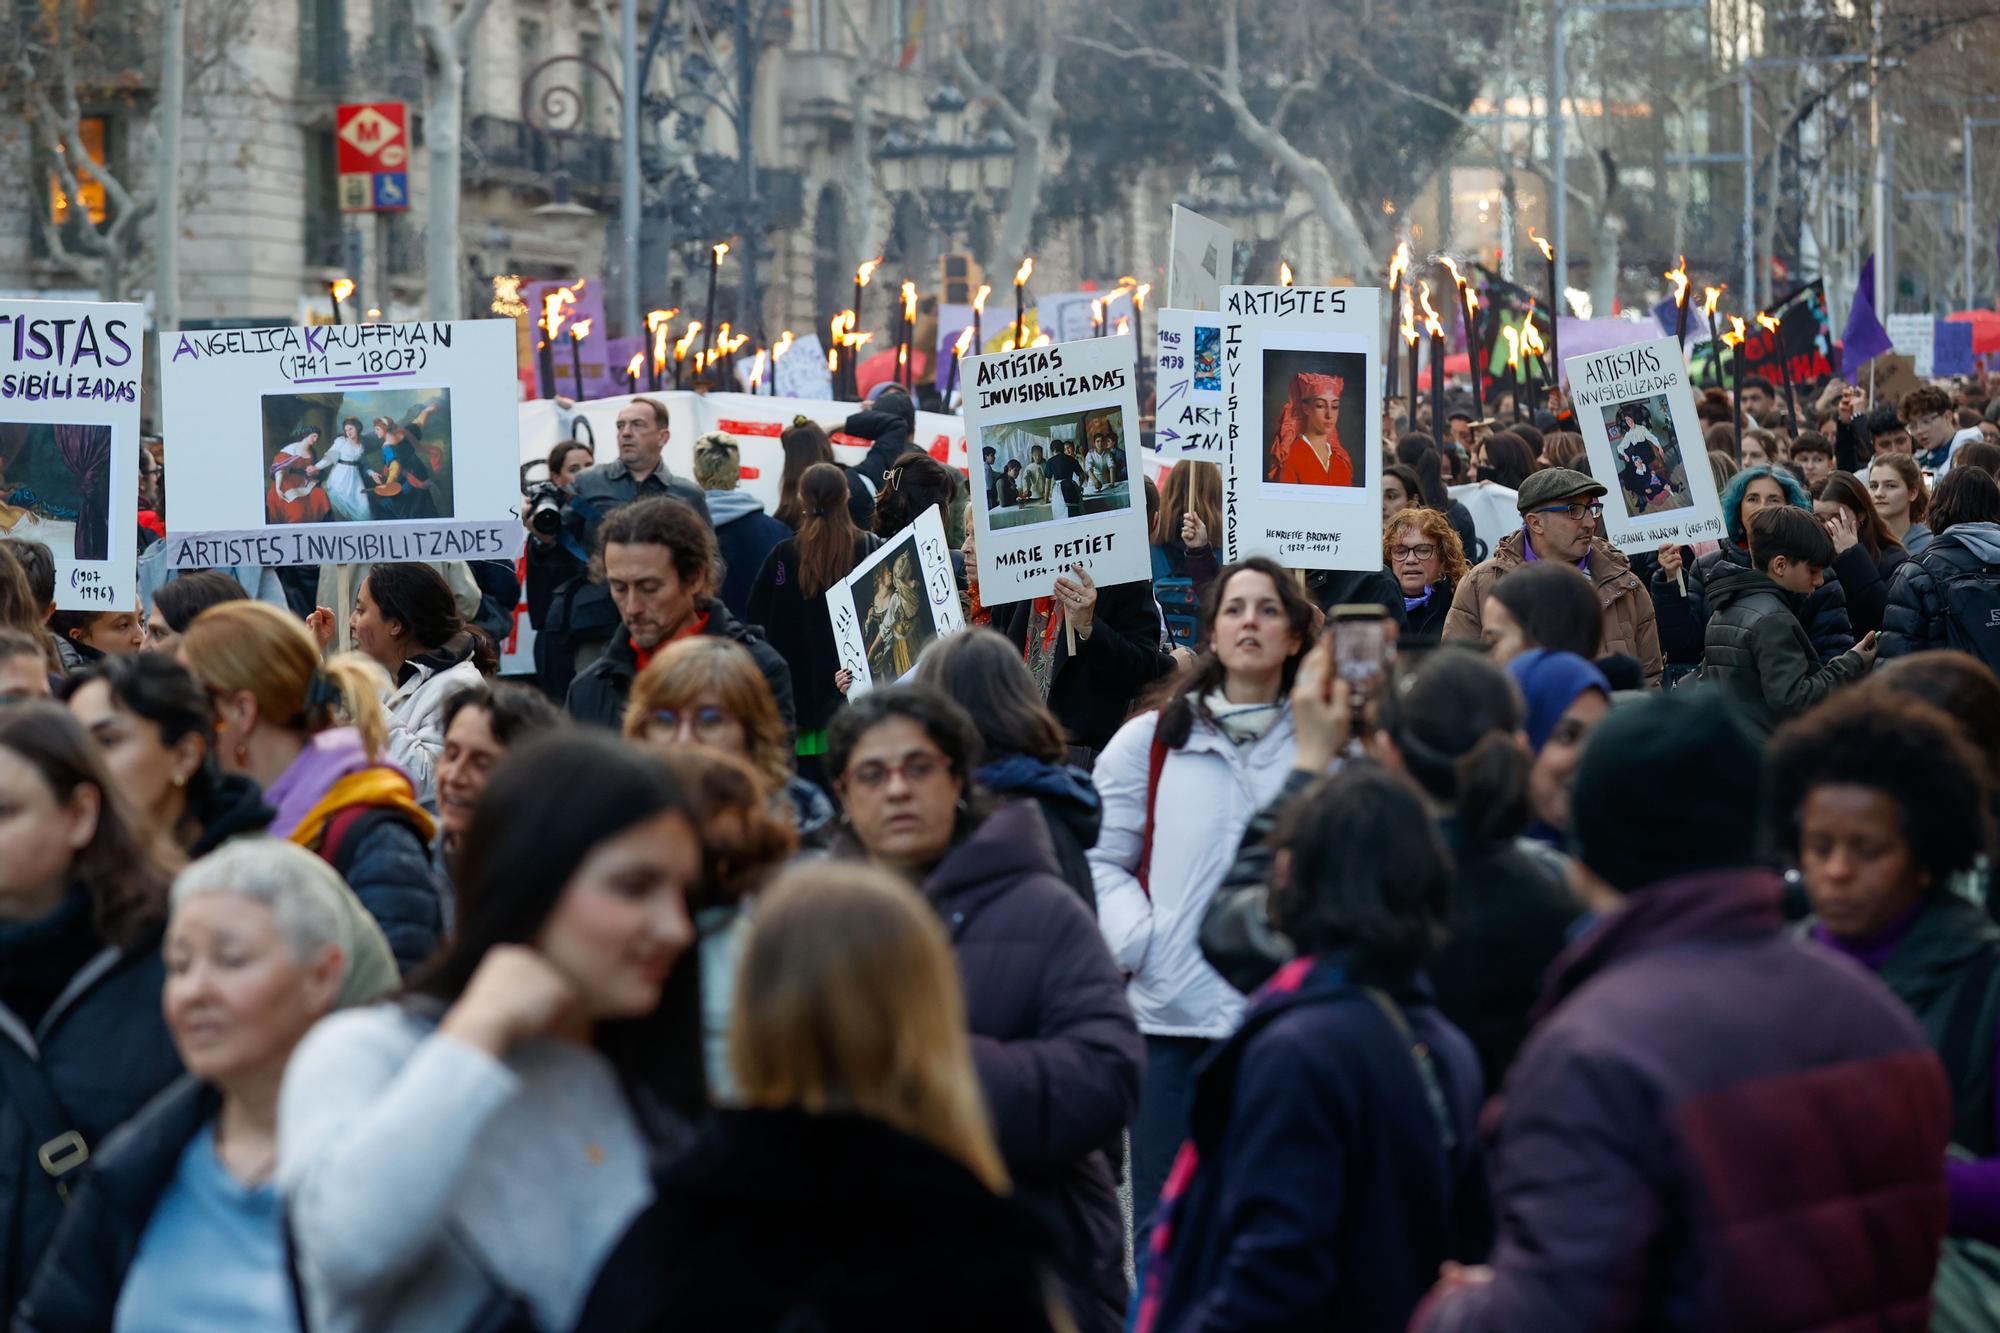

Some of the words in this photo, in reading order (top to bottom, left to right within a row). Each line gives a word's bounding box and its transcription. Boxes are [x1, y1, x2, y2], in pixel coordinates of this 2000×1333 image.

[357, 121, 380, 141] M
[1228, 290, 1346, 317] ARTISTES
[172, 326, 300, 362] ANGELICA
[304, 322, 451, 354] KAUFFMAN
[176, 535, 284, 565] ARTISTES
[291, 529, 504, 564] INVISIBILITZADES
[1306, 531, 1342, 542] BROWNE
[996, 545, 1042, 570] MARIE
